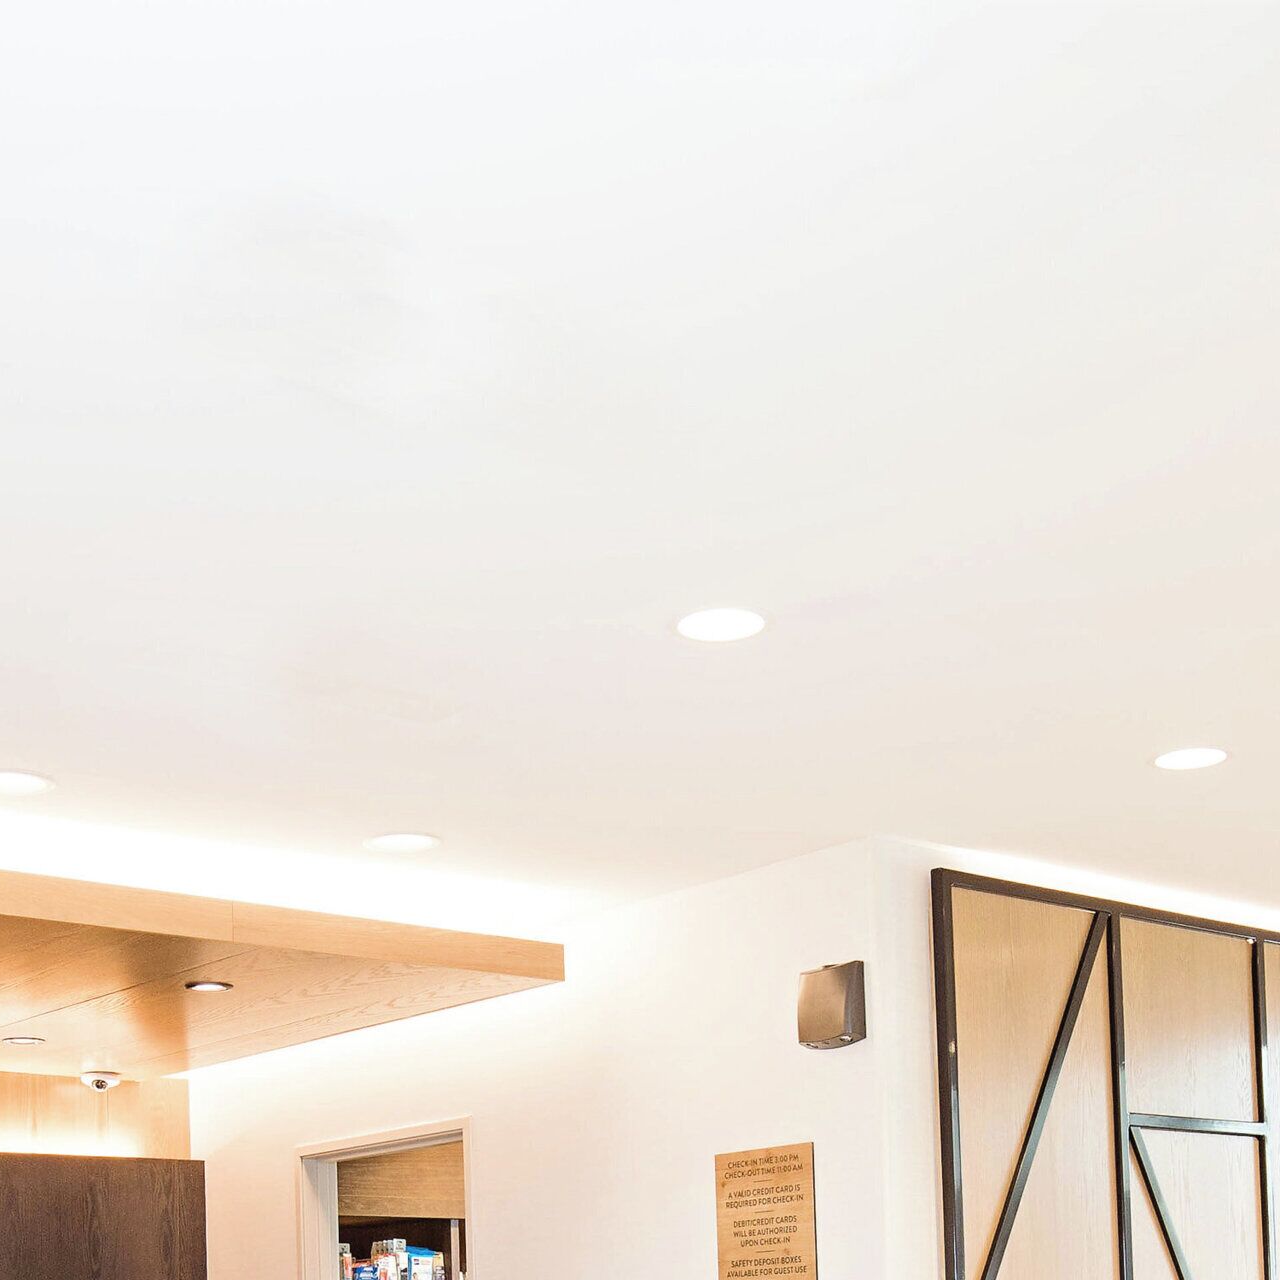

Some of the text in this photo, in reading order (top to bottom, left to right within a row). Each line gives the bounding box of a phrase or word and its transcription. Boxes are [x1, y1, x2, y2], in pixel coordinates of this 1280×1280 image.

[728, 1159, 757, 1169] CHECK-IN
[759, 1157, 773, 1166] TIME
[724, 1170, 760, 1179] CHECK-OUT
[761, 1167, 775, 1175] TIME
[734, 1190, 751, 1198] VALID
[752, 1187, 774, 1196] CREDIT
[776, 1185, 793, 1193] CARD
[726, 1199, 757, 1209] REQUIRED
[773, 1194, 803, 1204] CHECK-IN
[757, 1226, 797, 1235] AUTHORIZED
[760, 1237, 790, 1245] CHECK-IN
[731, 1256, 801, 1268] SAFETY DEPOSIT BOXES
[727, 1269, 758, 1278] AVAILABLE
[760, 1268, 772, 1276] FOR
[774, 1267, 793, 1275] GUEST
